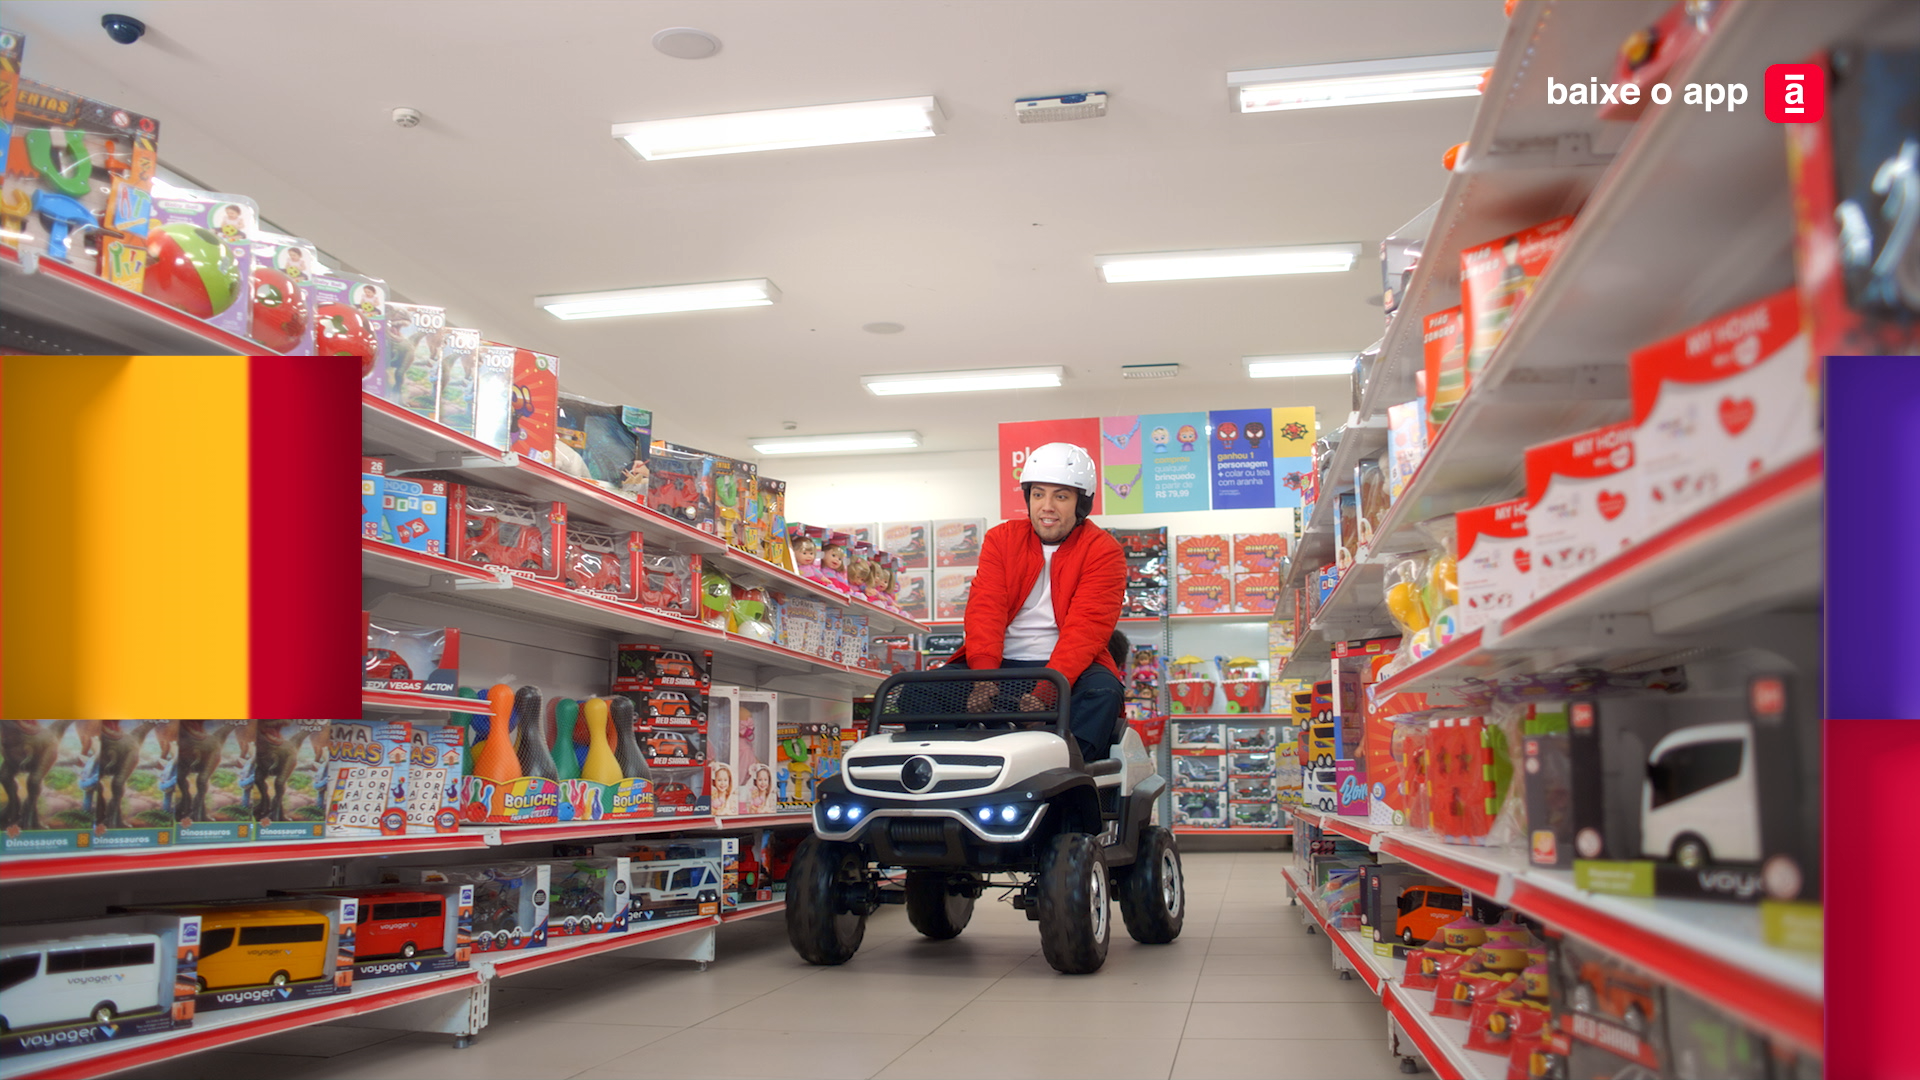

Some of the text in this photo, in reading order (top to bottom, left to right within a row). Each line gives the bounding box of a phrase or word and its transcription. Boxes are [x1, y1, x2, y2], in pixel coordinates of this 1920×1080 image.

[413, 313, 444, 329] 100
[1429, 315, 1449, 329] PIÃO
[1423, 325, 1456, 344] SONORO
[448, 335, 477, 350] 100
[484, 354, 512, 368] 100
[1572, 440, 1595, 458] MY
[1154, 456, 1190, 464] comprou
[1217, 452, 1248, 461] ganhou
[371, 461, 383, 471] 26
[1154, 464, 1188, 474] qualquer
[1217, 460, 1268, 470] personagem
[1155, 472, 1196, 481] brinquedo
[1225, 469, 1244, 477] colar
[1256, 469, 1271, 477] teia
[1161, 481, 1182, 491] partir
[1182, 481, 1193, 489] de
[1218, 477, 1263, 486] com aranha
[432, 482, 444, 492] 26
[1155, 489, 1190, 498] R$ 79,99
[1495, 505, 1511, 521] MY
[389, 681, 422, 690] VEGAS
[423, 682, 454, 692] ACTON
[661, 677, 696, 686] RED SHARK
[655, 717, 692, 725] RED SHARK
[653, 757, 691, 765] RED SHARK
[350, 768, 389, 778] COPO
[347, 780, 386, 791] FLOR
[345, 790, 384, 800] FACA
[613, 793, 654, 807] BOLICHE
[505, 793, 558, 809] BOLICHE
[338, 802, 382, 813] MAÇÃ
[339, 814, 380, 825] FOGO
[180, 828, 231, 837] Dinossauros
[260, 827, 307, 835] Dinossauros
[5, 836, 68, 848] Dinossauros
[93, 835, 150, 845] Dinossauros
[1430, 912, 1450, 920] voyager
[380, 922, 410, 931] voyager
[247, 949, 284, 958] voyager
[360, 961, 408, 975] voyager
[67, 973, 113, 985] voyager
[216, 987, 276, 1004] voyager
[1573, 1013, 1597, 1040] RED
[19, 1026, 98, 1048] voyager
